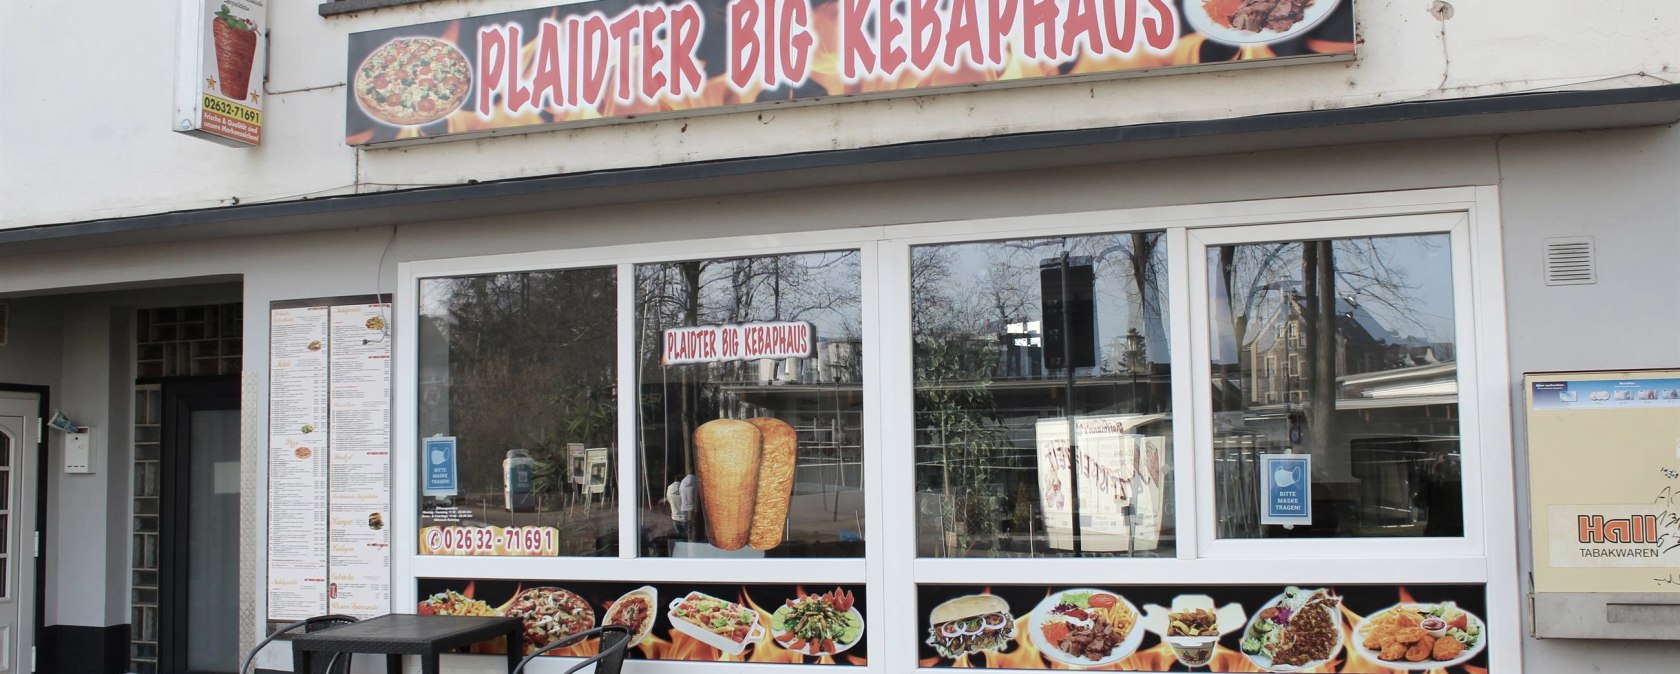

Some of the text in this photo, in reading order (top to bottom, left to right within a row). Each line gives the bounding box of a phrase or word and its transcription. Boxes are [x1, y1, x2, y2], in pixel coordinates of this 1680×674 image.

[479, 0, 1176, 116] PLAIDTER BIG KEBAPHAUS
[204, 97, 259, 123] 02632-71691
[204, 112, 221, 123] Frische
[203, 121, 221, 130] unsere
[667, 324, 807, 360] PLAIDTER BIG KEBAPHAUS
[1577, 514, 1658, 544] Hall
[1579, 548, 1659, 558] TABAKWAREN
